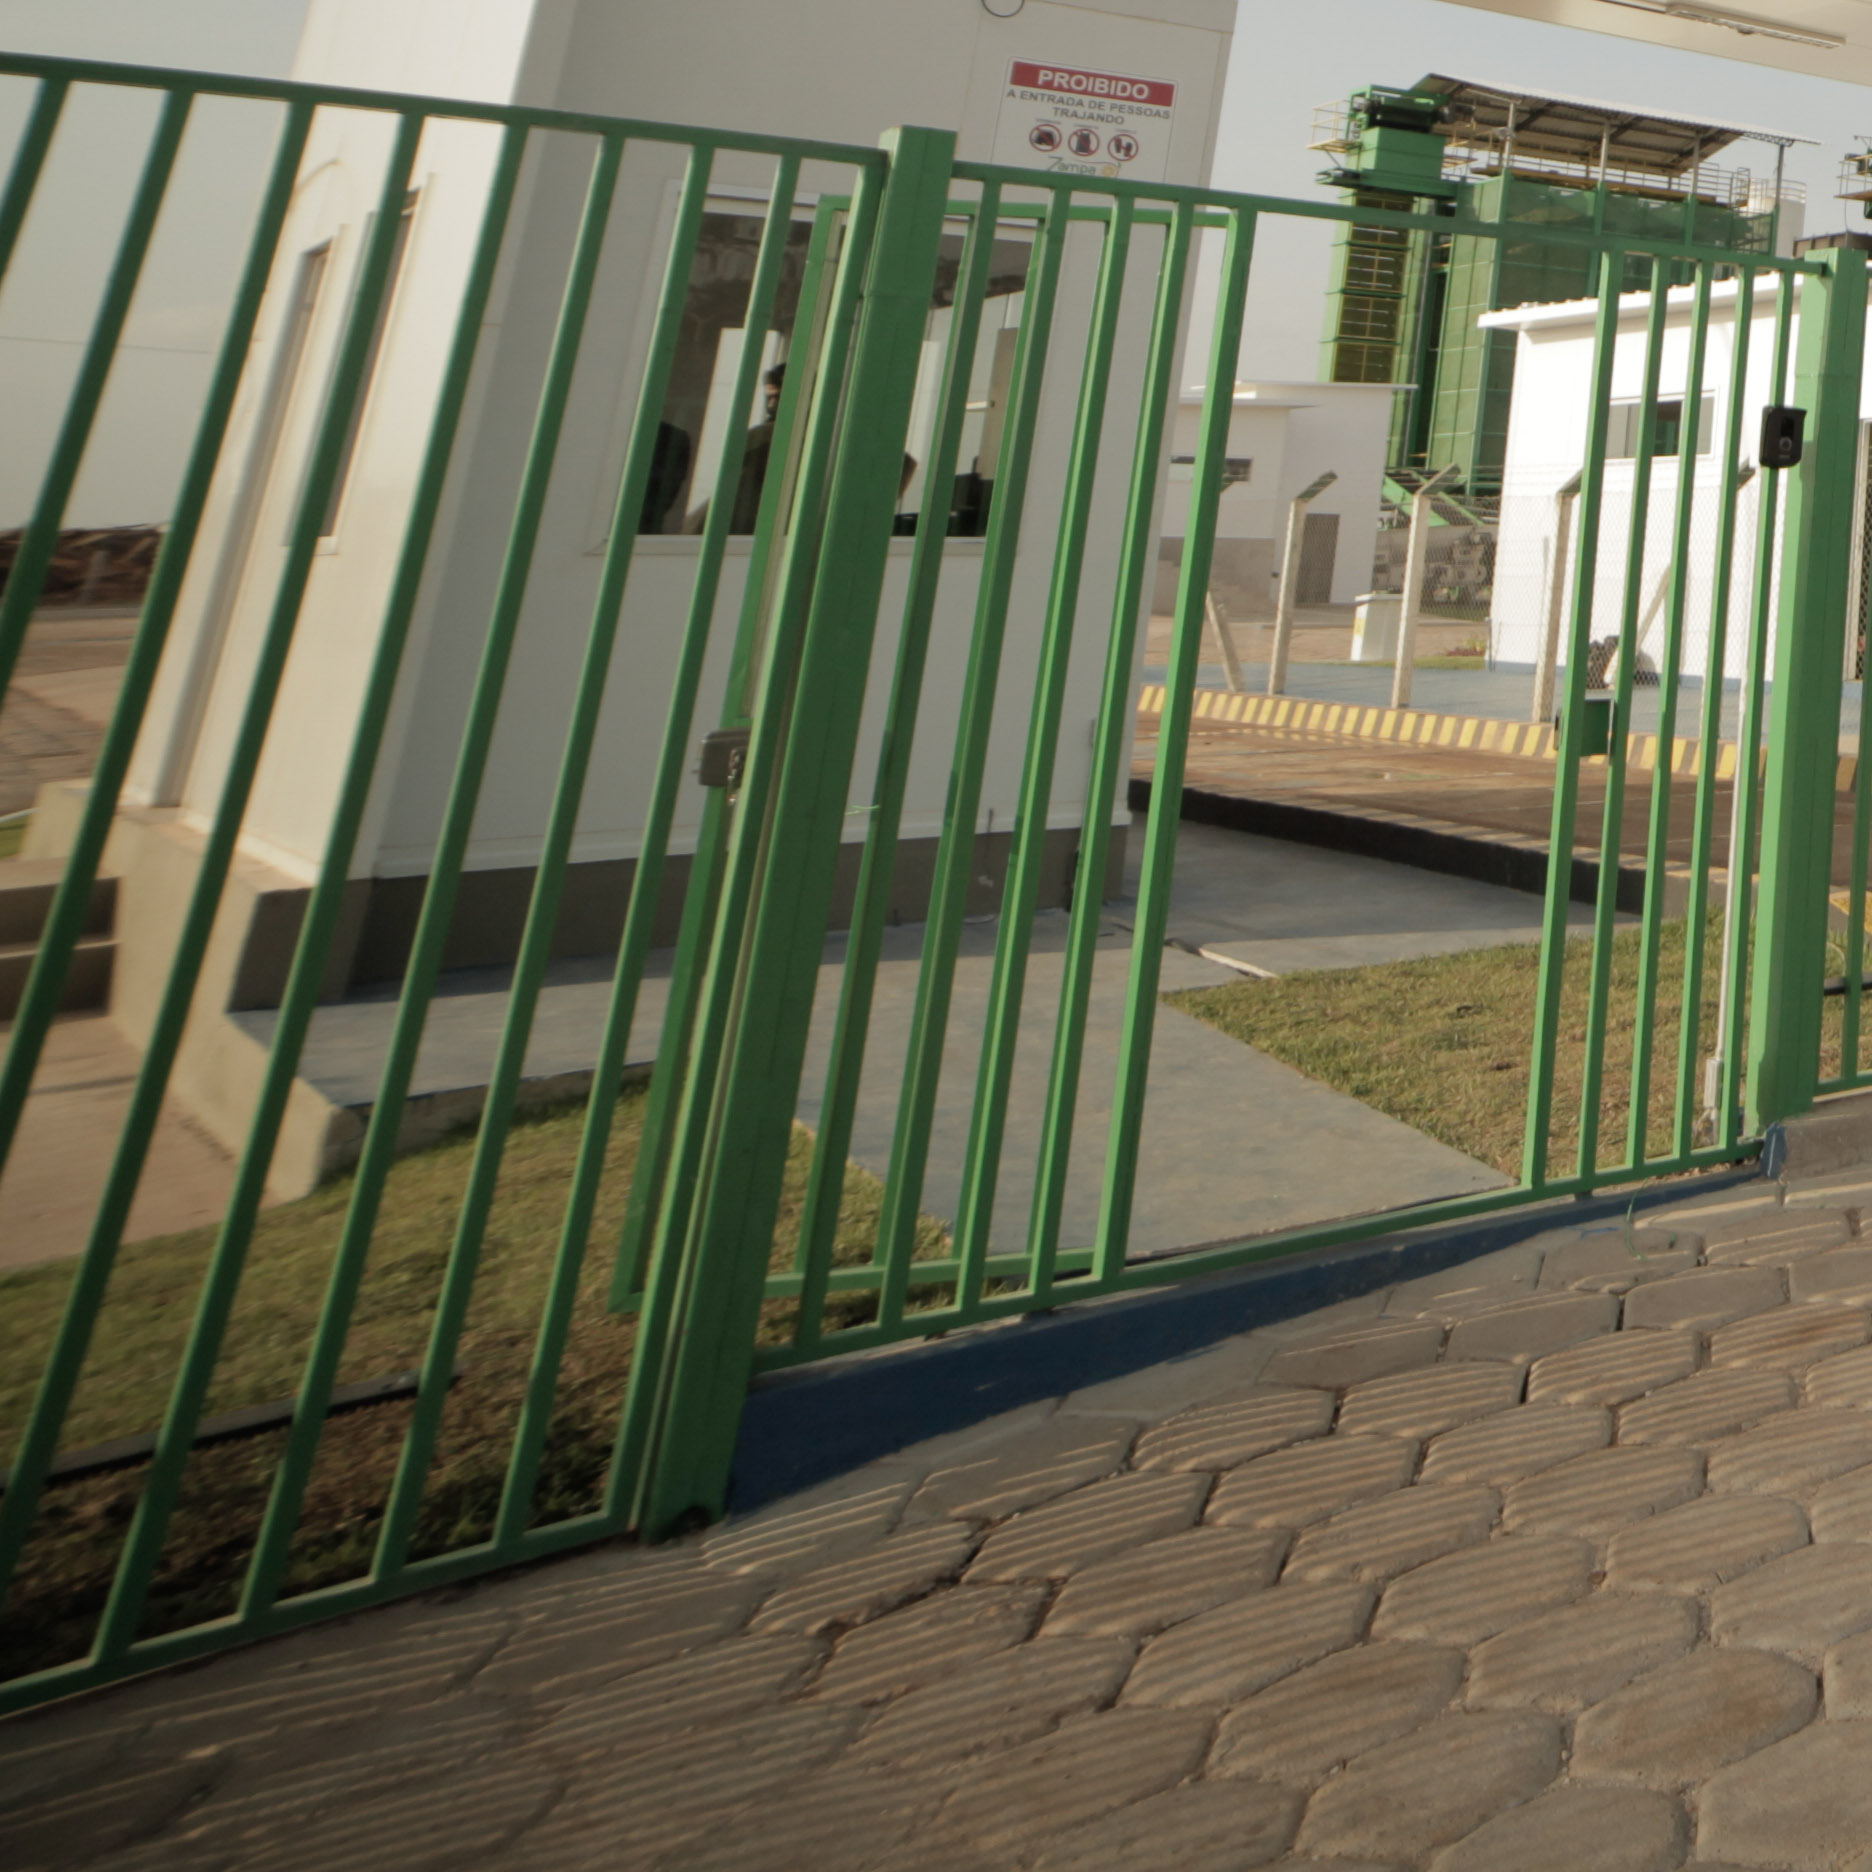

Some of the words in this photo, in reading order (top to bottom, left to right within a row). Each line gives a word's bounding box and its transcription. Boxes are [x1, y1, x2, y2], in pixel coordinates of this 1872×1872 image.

[1037, 69, 1149, 100] PROIBIDO
[1006, 88, 1016, 99] A
[1020, 89, 1085, 108] ENTRADA
[1088, 99, 1105, 111] DE
[1109, 102, 1171, 120] PESSOAS
[1052, 106, 1125, 125] TRAJANDO
